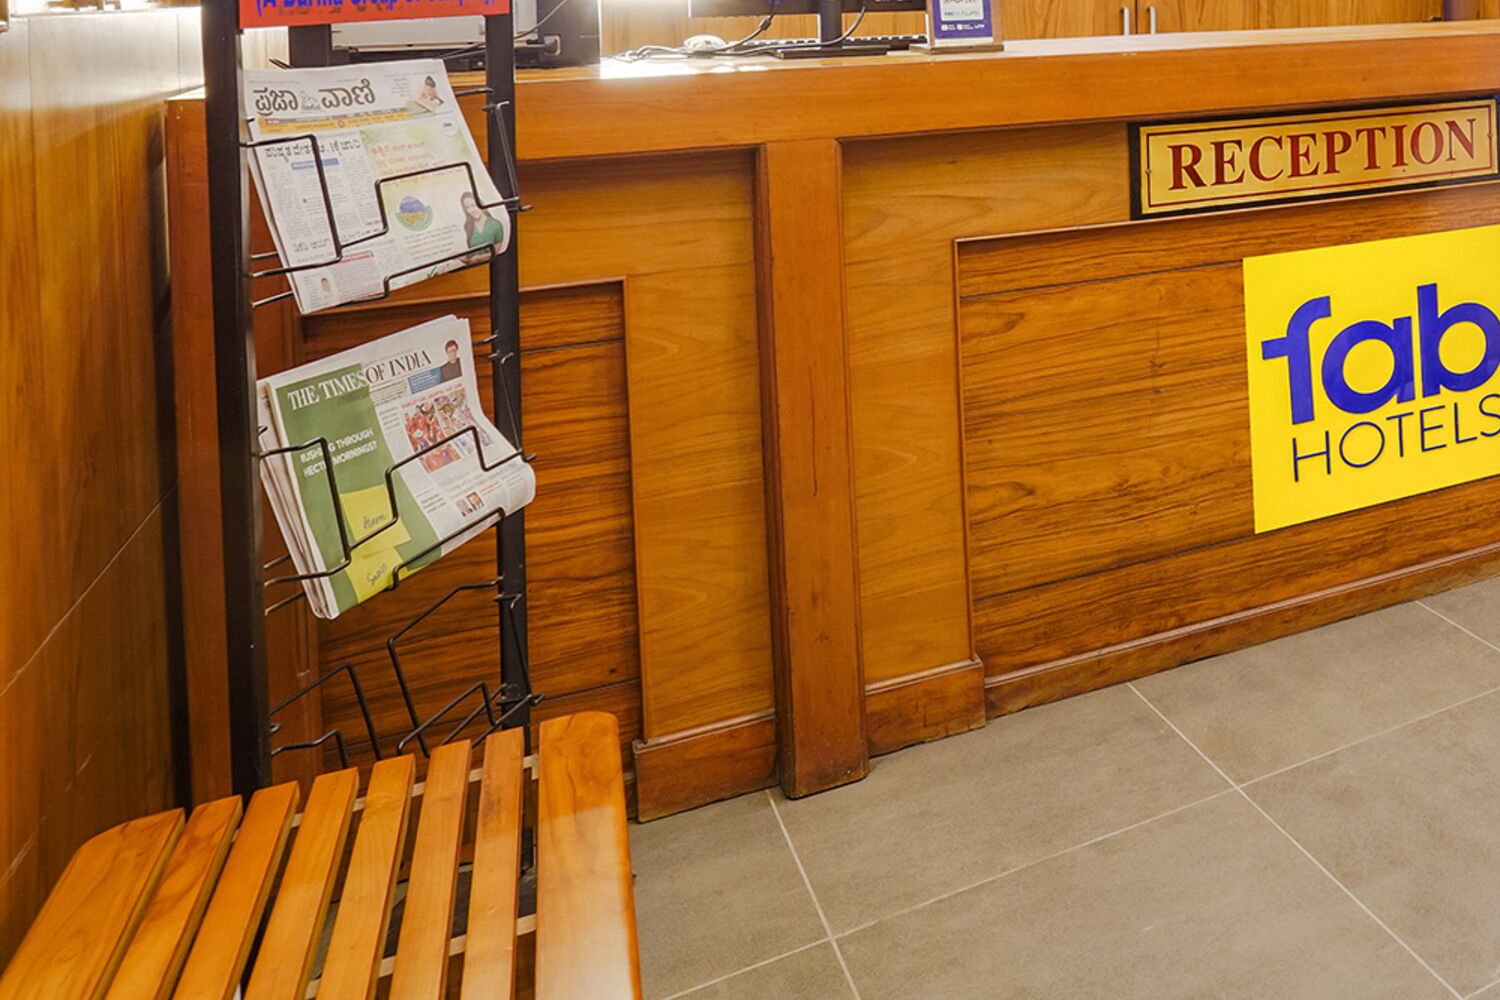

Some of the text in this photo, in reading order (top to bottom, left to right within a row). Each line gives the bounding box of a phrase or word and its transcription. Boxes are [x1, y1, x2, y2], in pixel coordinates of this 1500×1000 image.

[1167, 117, 1477, 192] RECEPTION
[287, 385, 320, 411] THE
[318, 370, 371, 400] TIMES
[366, 364, 386, 384] OF
[389, 350, 432, 377] INDIA
[300, 428, 374, 463] RUSHIG THROUGH
[303, 460, 328, 478] HECTI
